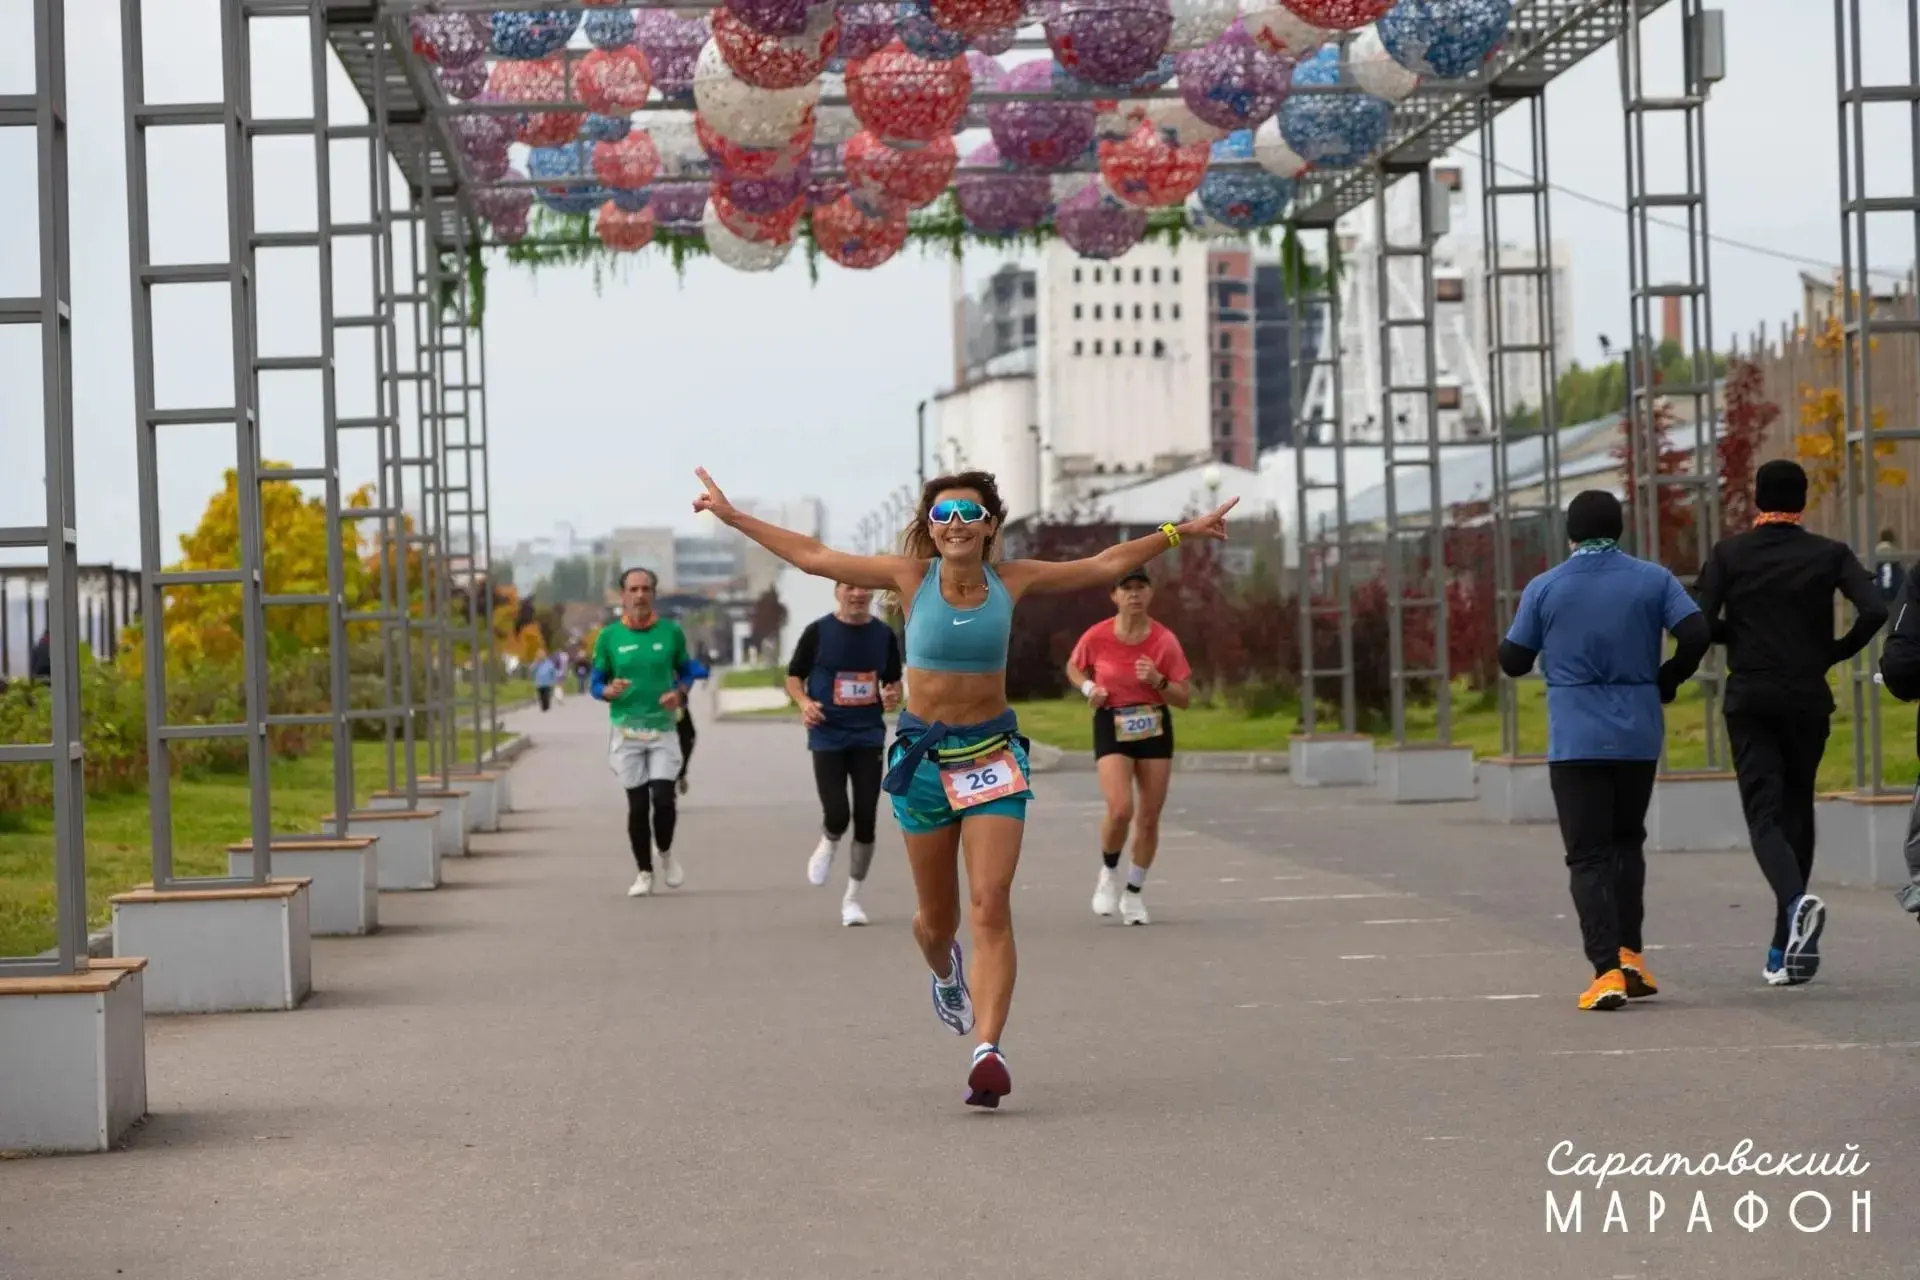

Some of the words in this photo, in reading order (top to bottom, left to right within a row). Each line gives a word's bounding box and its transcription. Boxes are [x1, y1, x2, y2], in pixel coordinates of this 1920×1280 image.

[852, 684, 867, 696] 14
[1127, 717, 1152, 731] 201
[966, 768, 998, 790] 26
